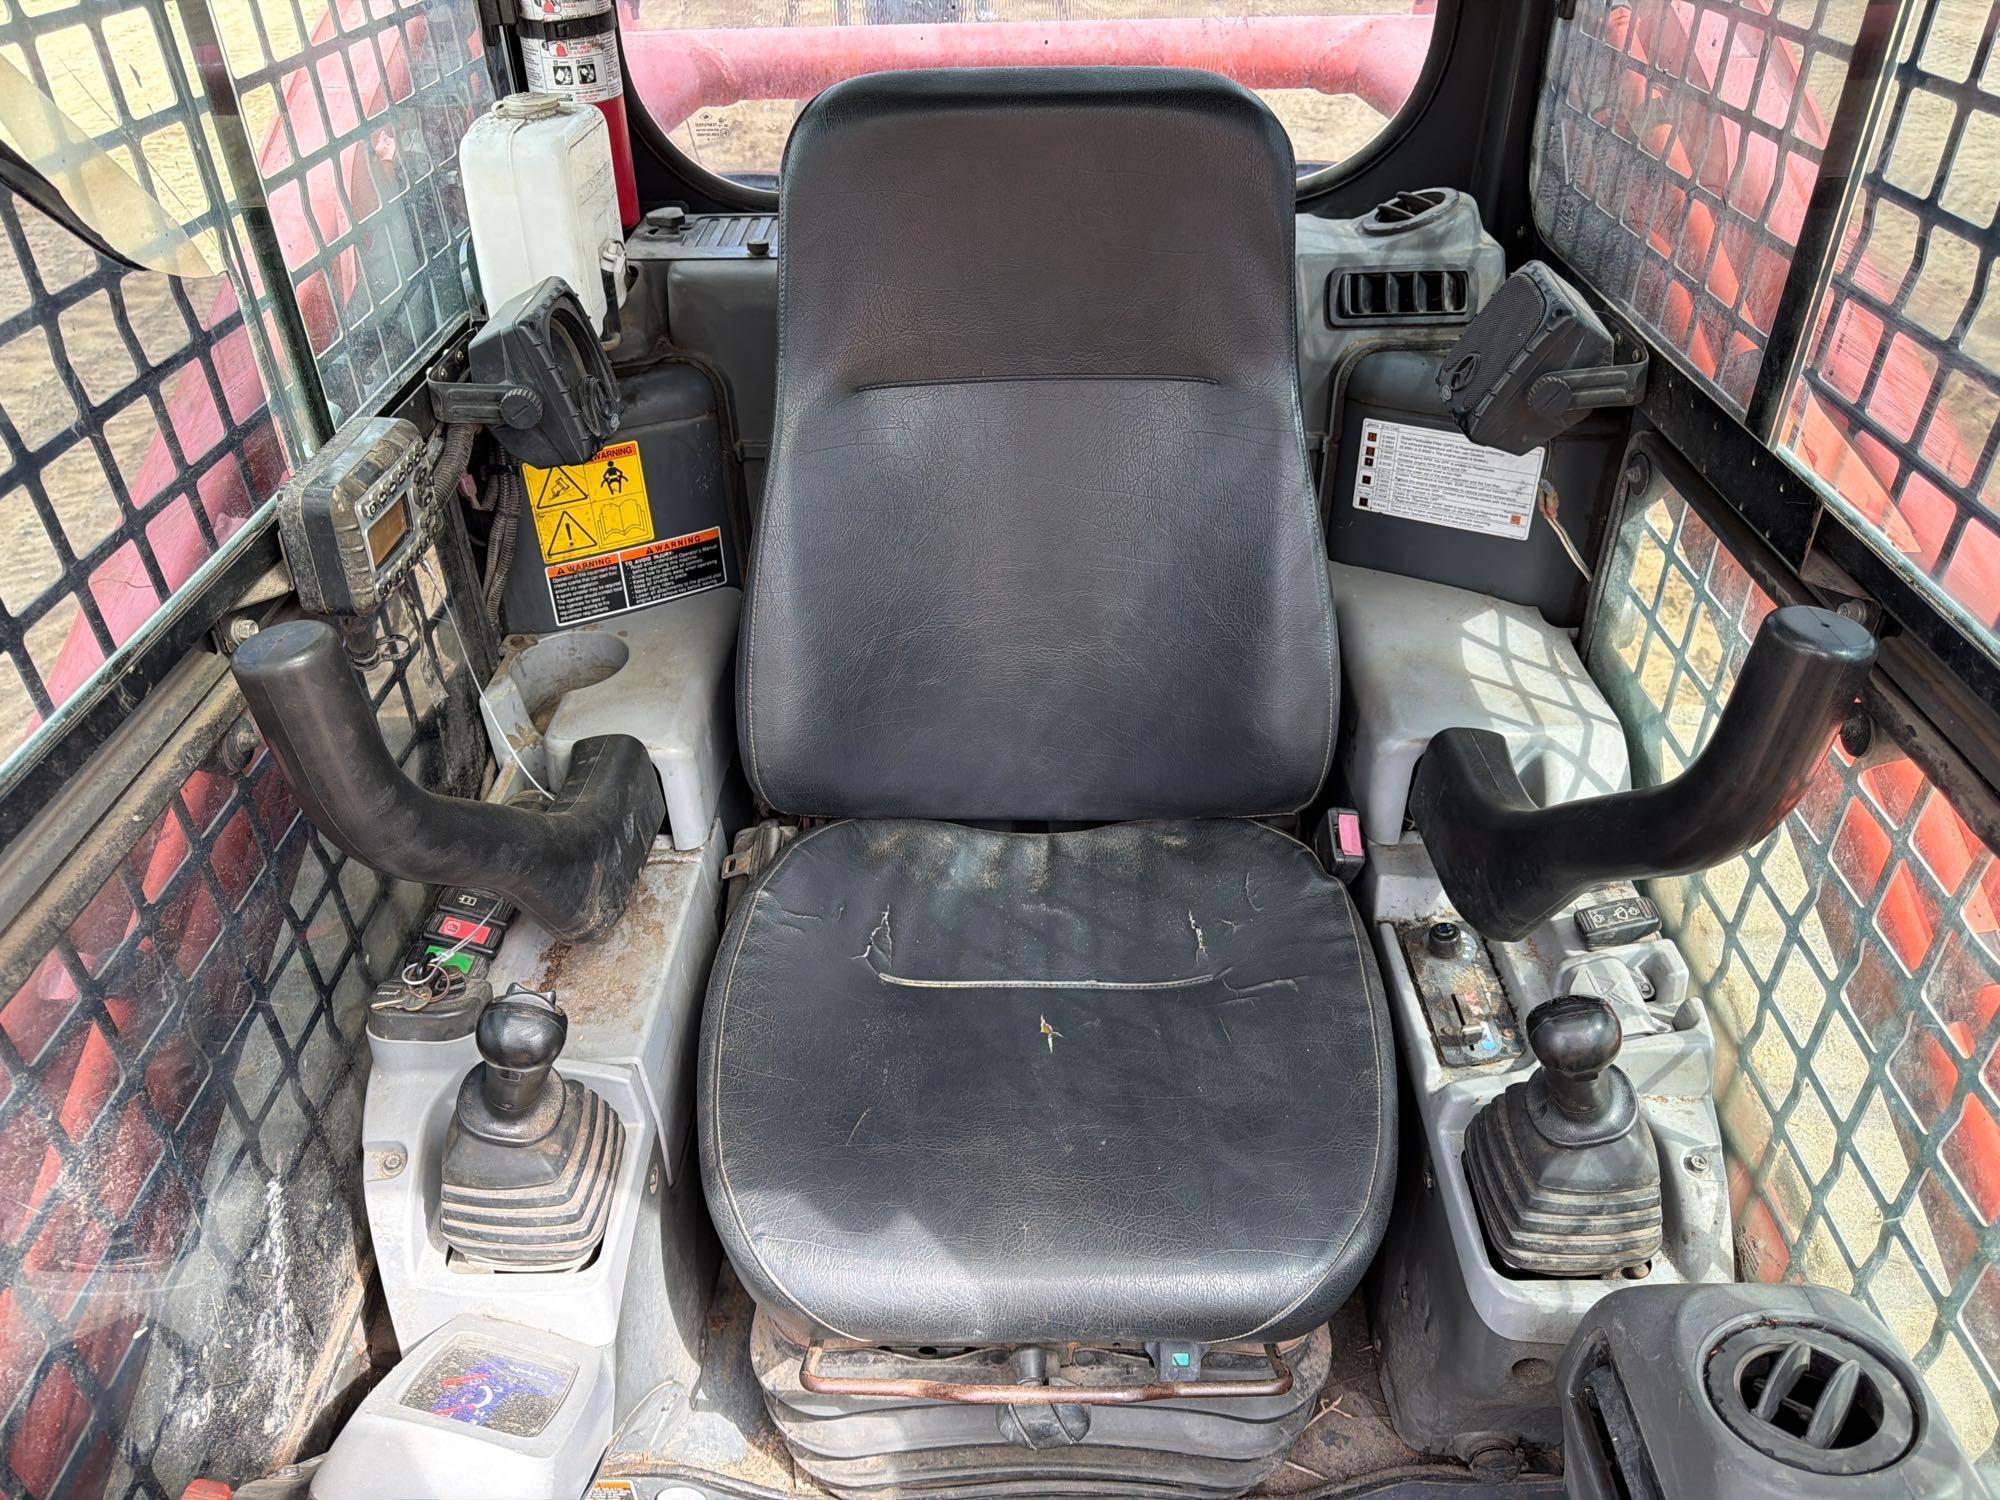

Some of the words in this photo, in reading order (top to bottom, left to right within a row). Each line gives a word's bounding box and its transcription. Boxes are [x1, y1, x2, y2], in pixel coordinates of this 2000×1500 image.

[594, 446, 632, 460] WARNING
[655, 535, 701, 551] WARNING
[567, 557, 611, 572] WARNING
[635, 556, 651, 564] AVOID
